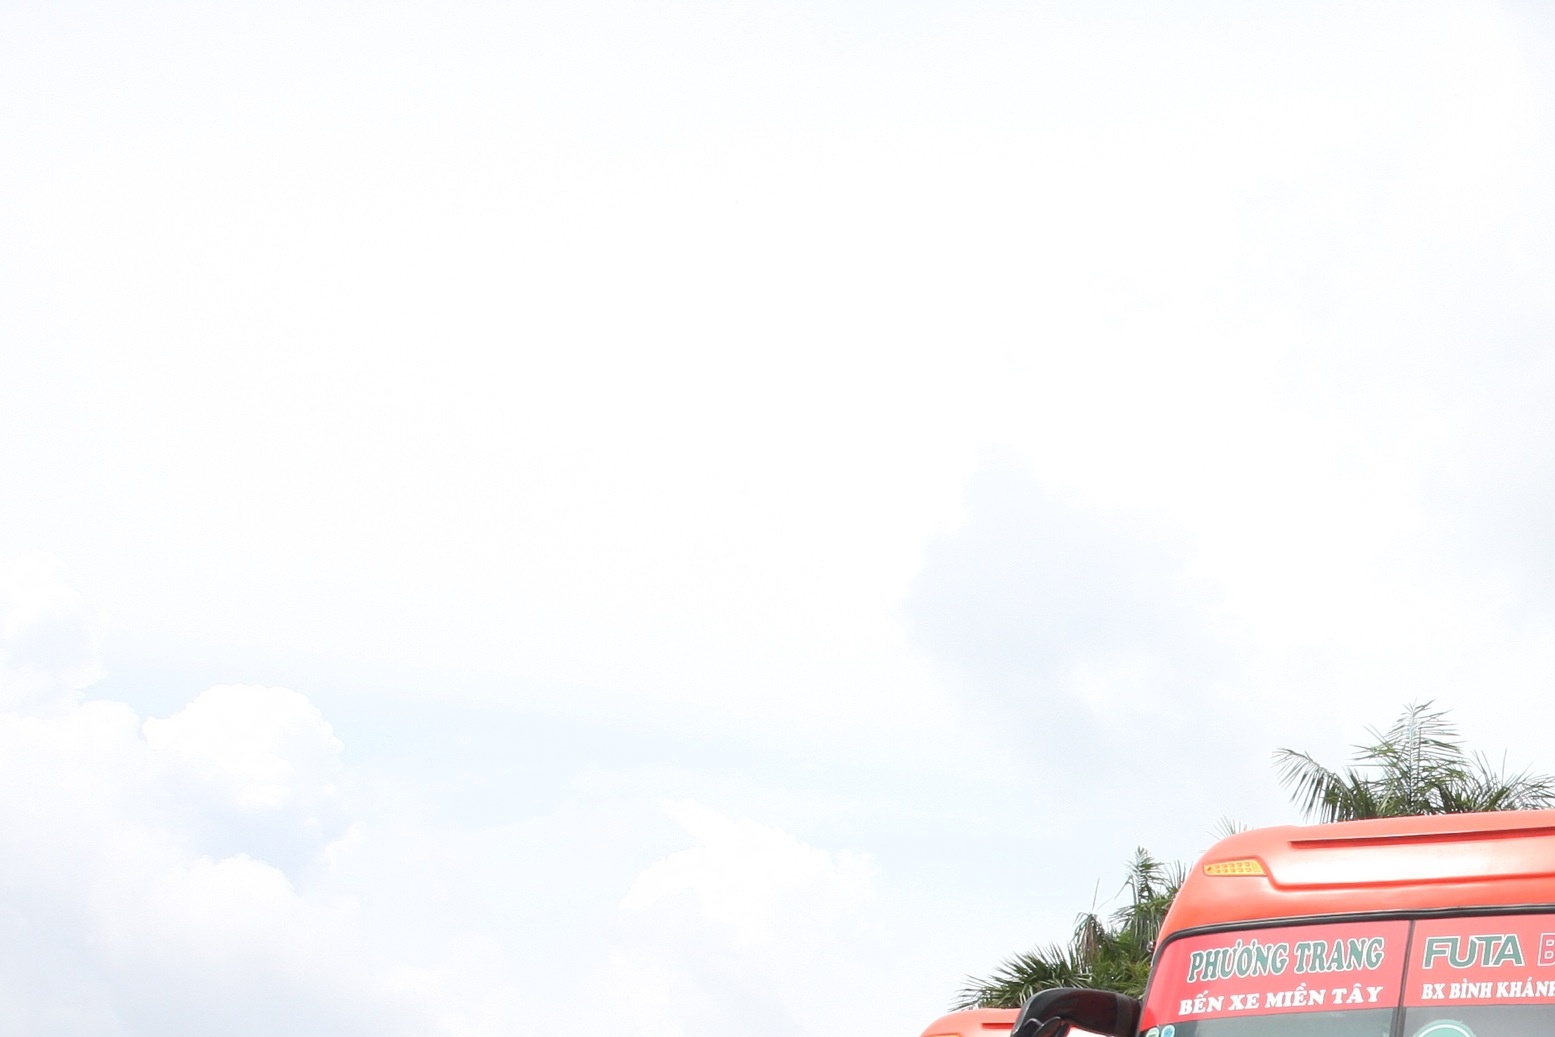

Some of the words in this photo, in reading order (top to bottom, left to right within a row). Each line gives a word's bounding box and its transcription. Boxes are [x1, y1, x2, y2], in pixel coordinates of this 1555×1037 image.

[1186, 939, 1289, 983] PHƯƠNG
[1294, 937, 1384, 974] TRANG
[1422, 933, 1526, 969] FUTA
[1178, 990, 1224, 1016] BẾN
[1228, 993, 1260, 1011] XE
[1264, 982, 1326, 1008] MIỀN
[1331, 982, 1383, 1004] TÂY
[1421, 983, 1446, 1000] BX
[1448, 978, 1497, 1000] BÌNH
